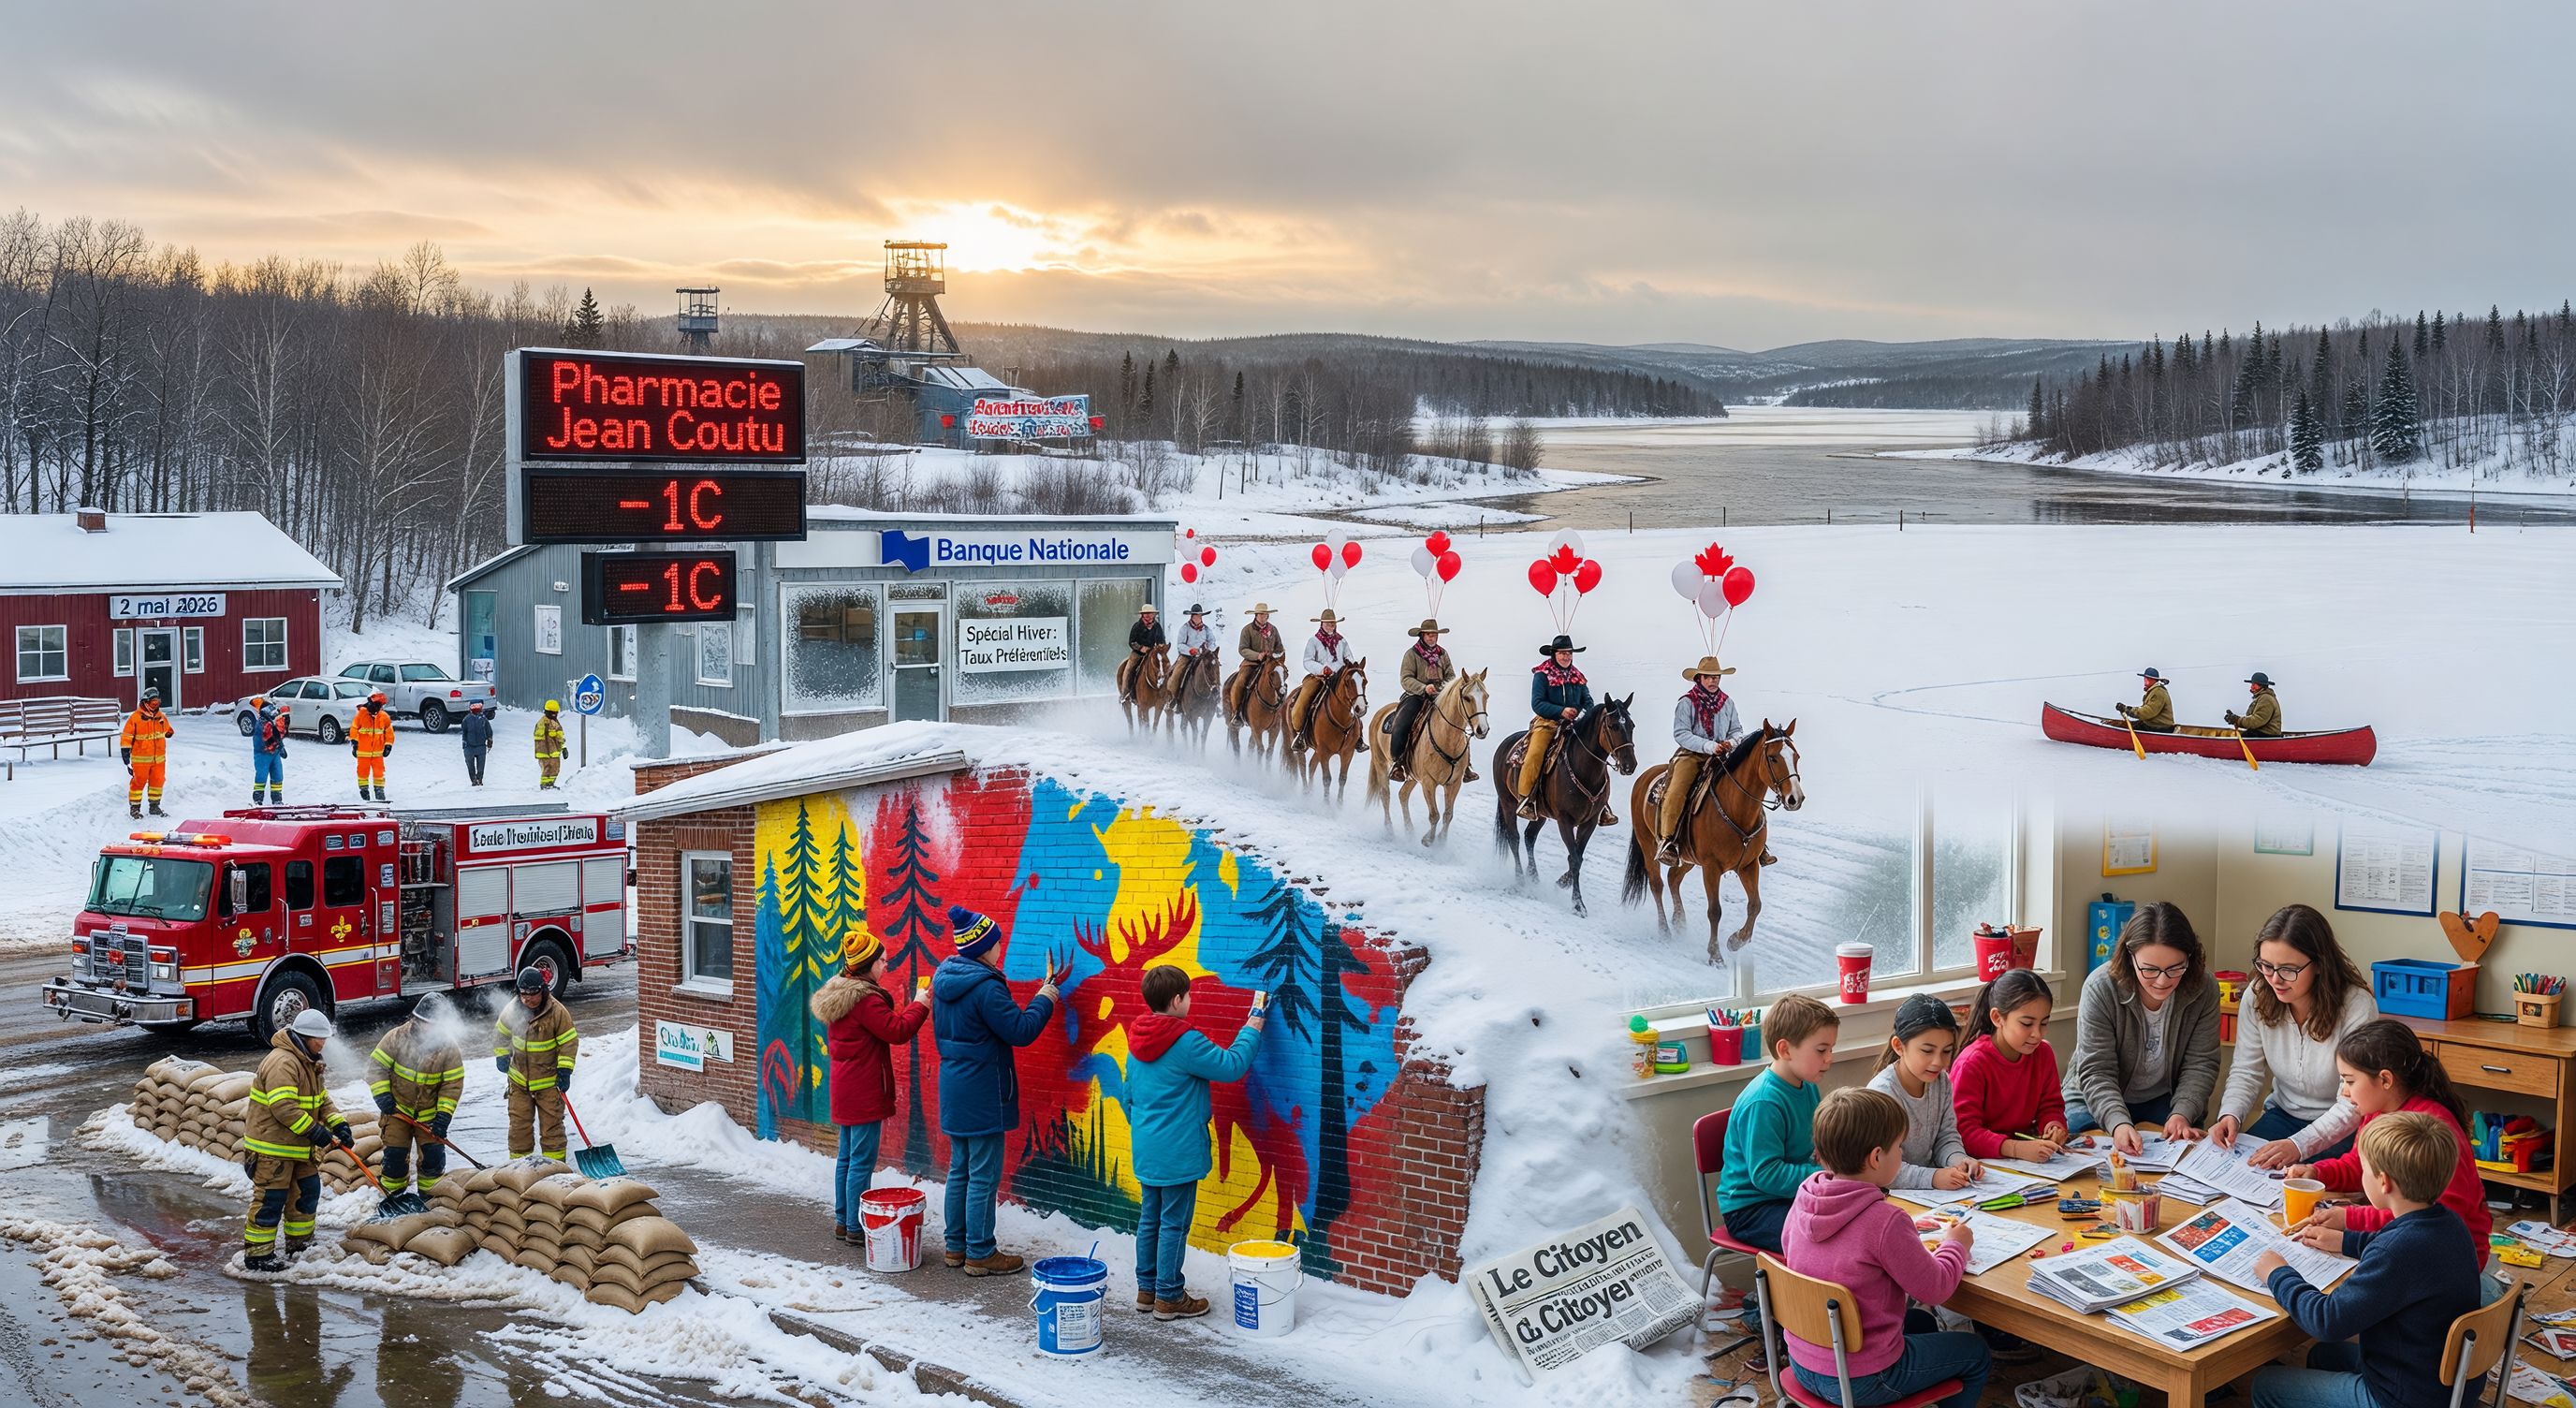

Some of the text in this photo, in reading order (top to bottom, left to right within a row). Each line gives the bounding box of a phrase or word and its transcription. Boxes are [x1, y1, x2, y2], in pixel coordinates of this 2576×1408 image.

[553, 360, 782, 410] Pharmacie
[547, 406, 784, 452] Jean Coutu
[620, 479, 723, 531] -1C
[937, 537, 1129, 565] Banque Nationale
[120, 596, 218, 615] 2 mai 2026
[620, 561, 723, 611] -1C
[960, 649, 992, 666] Taux
[966, 623, 1057, 646] Spécial Hiver:
[1486, 1267, 1533, 1298] Le
[1533, 1221, 1645, 1278] Citoyen
